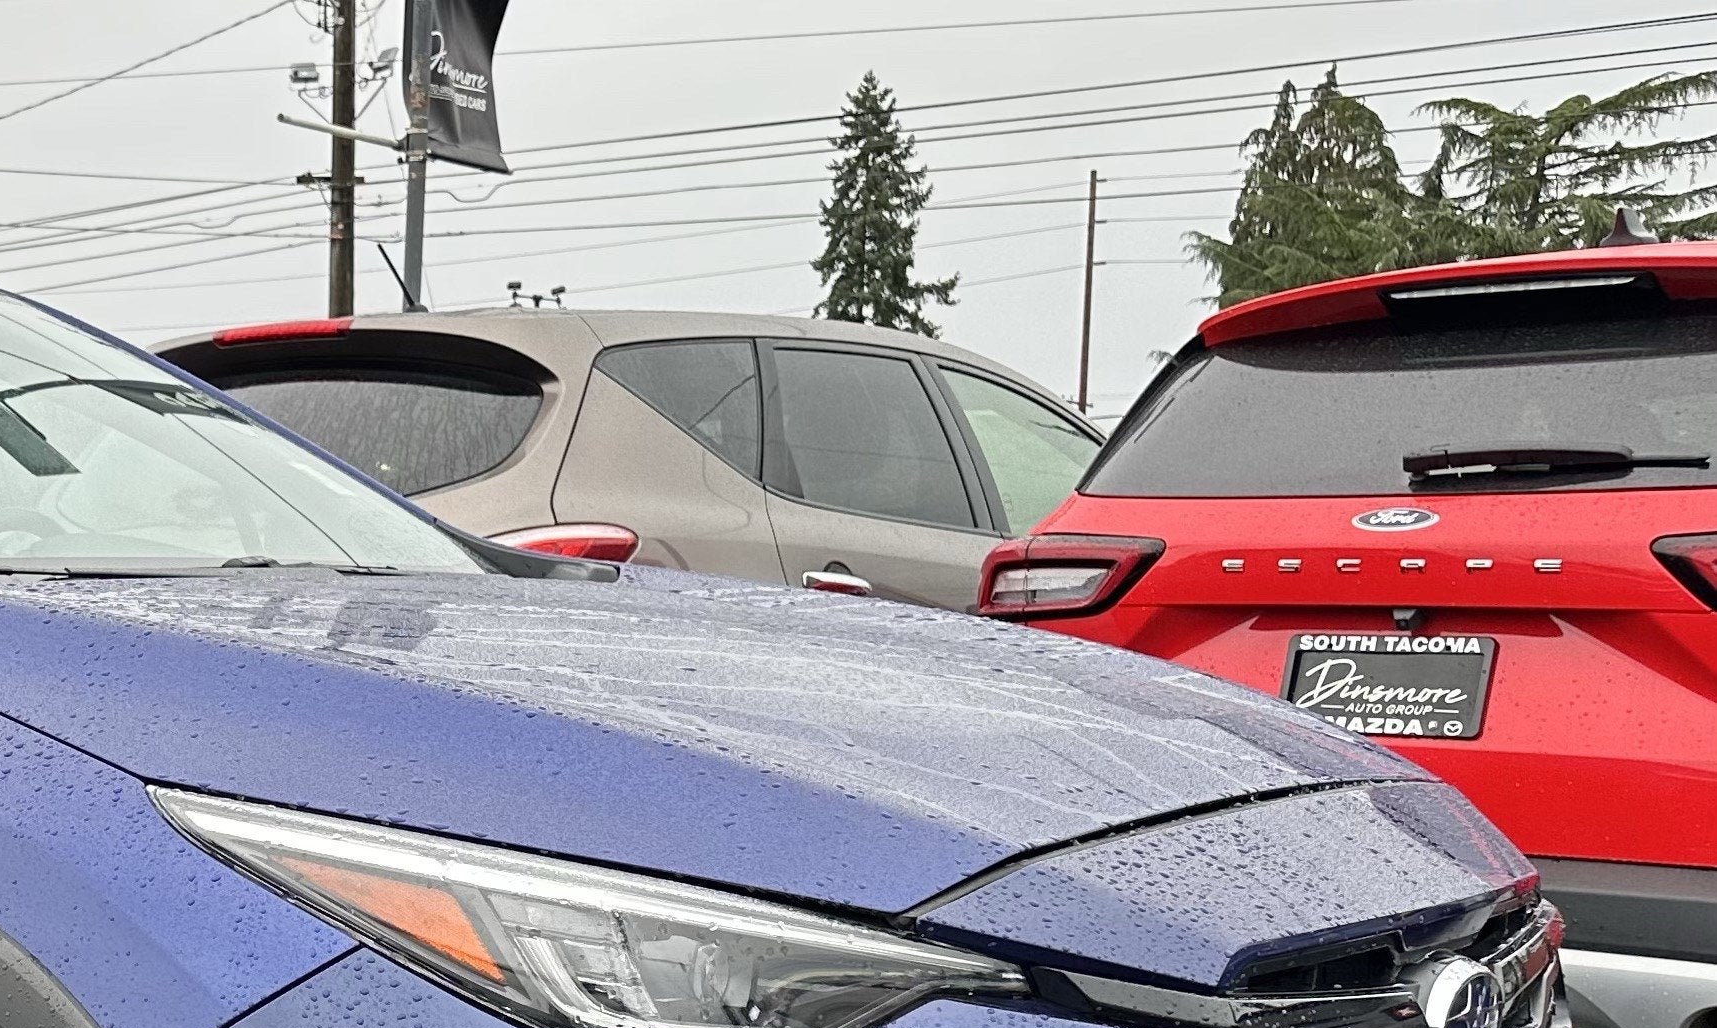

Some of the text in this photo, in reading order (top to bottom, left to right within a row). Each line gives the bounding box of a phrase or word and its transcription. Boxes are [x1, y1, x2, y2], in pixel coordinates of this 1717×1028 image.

[1369, 510, 1420, 525] Ford
[1221, 558, 1563, 573] ESCAPE
[1299, 634, 1481, 654] SOUTH TACOMA
[1295, 658, 1468, 709] Dinsmore
[1344, 702, 1433, 716] AUTO GROUP
